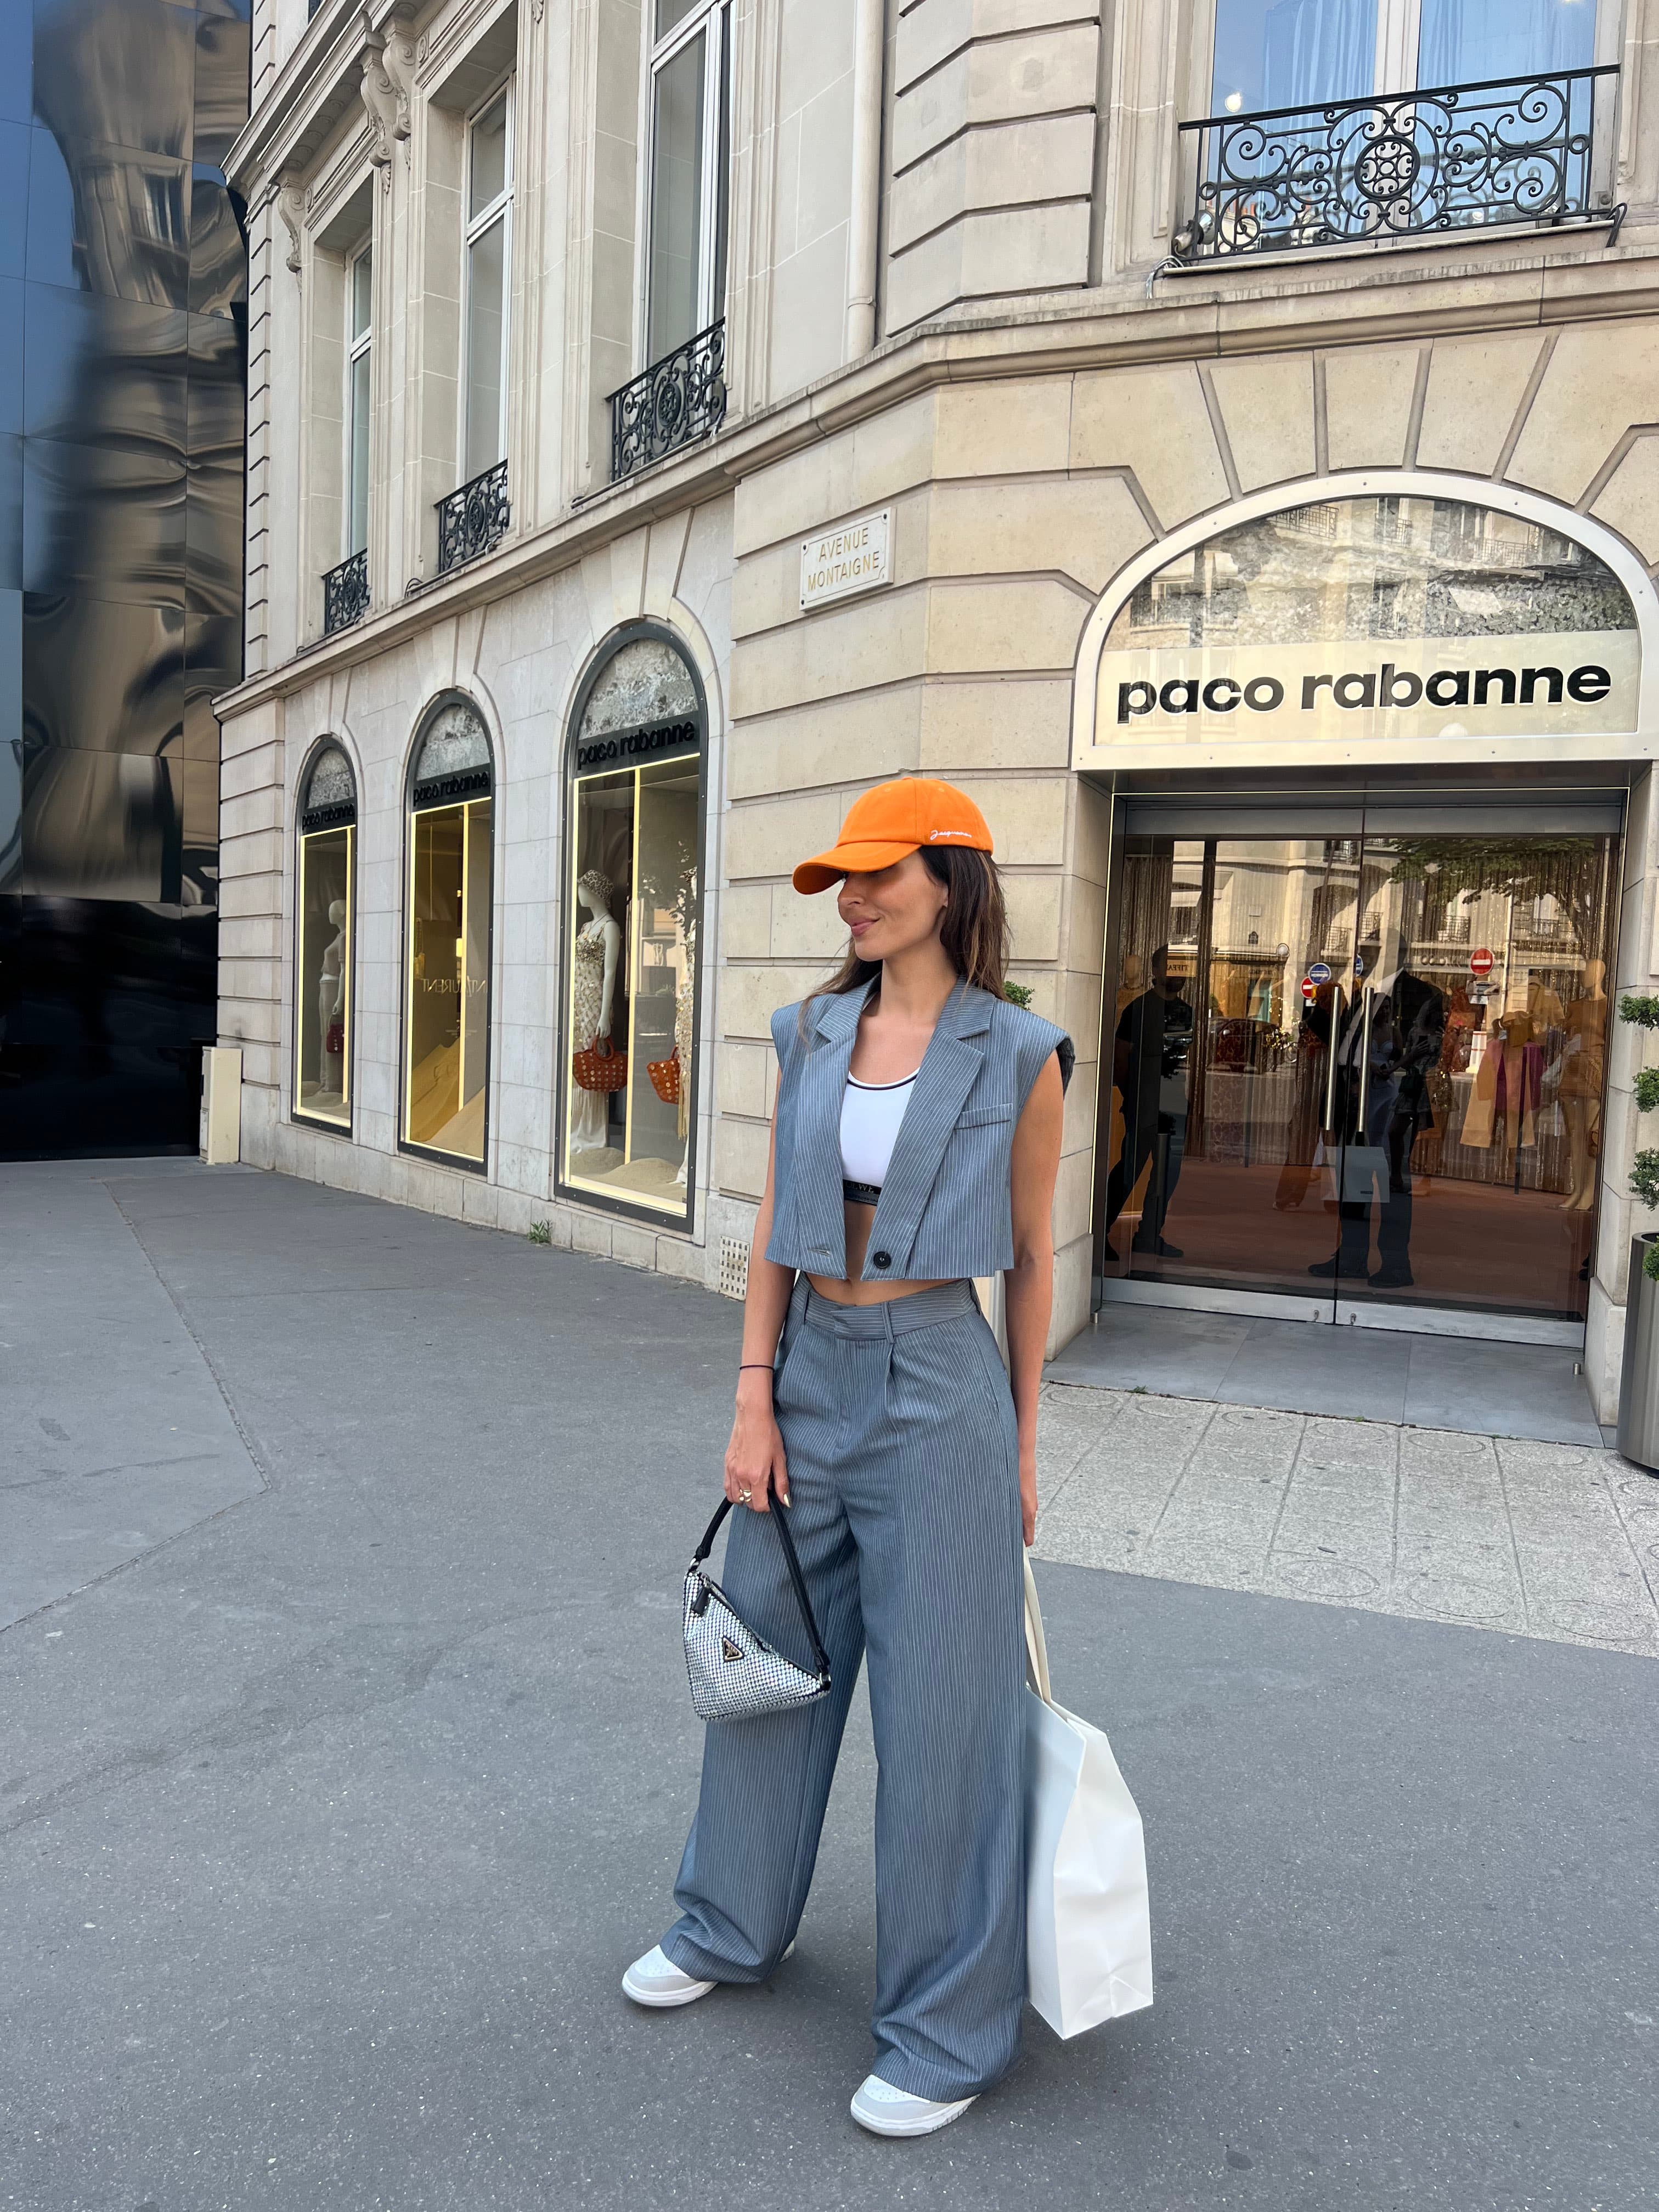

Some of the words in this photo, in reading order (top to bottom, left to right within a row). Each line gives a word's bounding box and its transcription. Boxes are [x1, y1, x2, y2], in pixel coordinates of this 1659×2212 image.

[819, 527, 869, 562] AVENUE
[807, 551, 879, 592] MONTAIGNE
[1118, 676, 1284, 724] paco
[1301, 663, 1612, 710] rabanne
[578, 740, 617, 770] paco
[620, 721, 695, 756] rabanne
[413, 784, 439, 806] paco
[441, 771, 488, 797] rabanne
[302, 812, 320, 830] paco
[320, 804, 355, 824] rabanne
